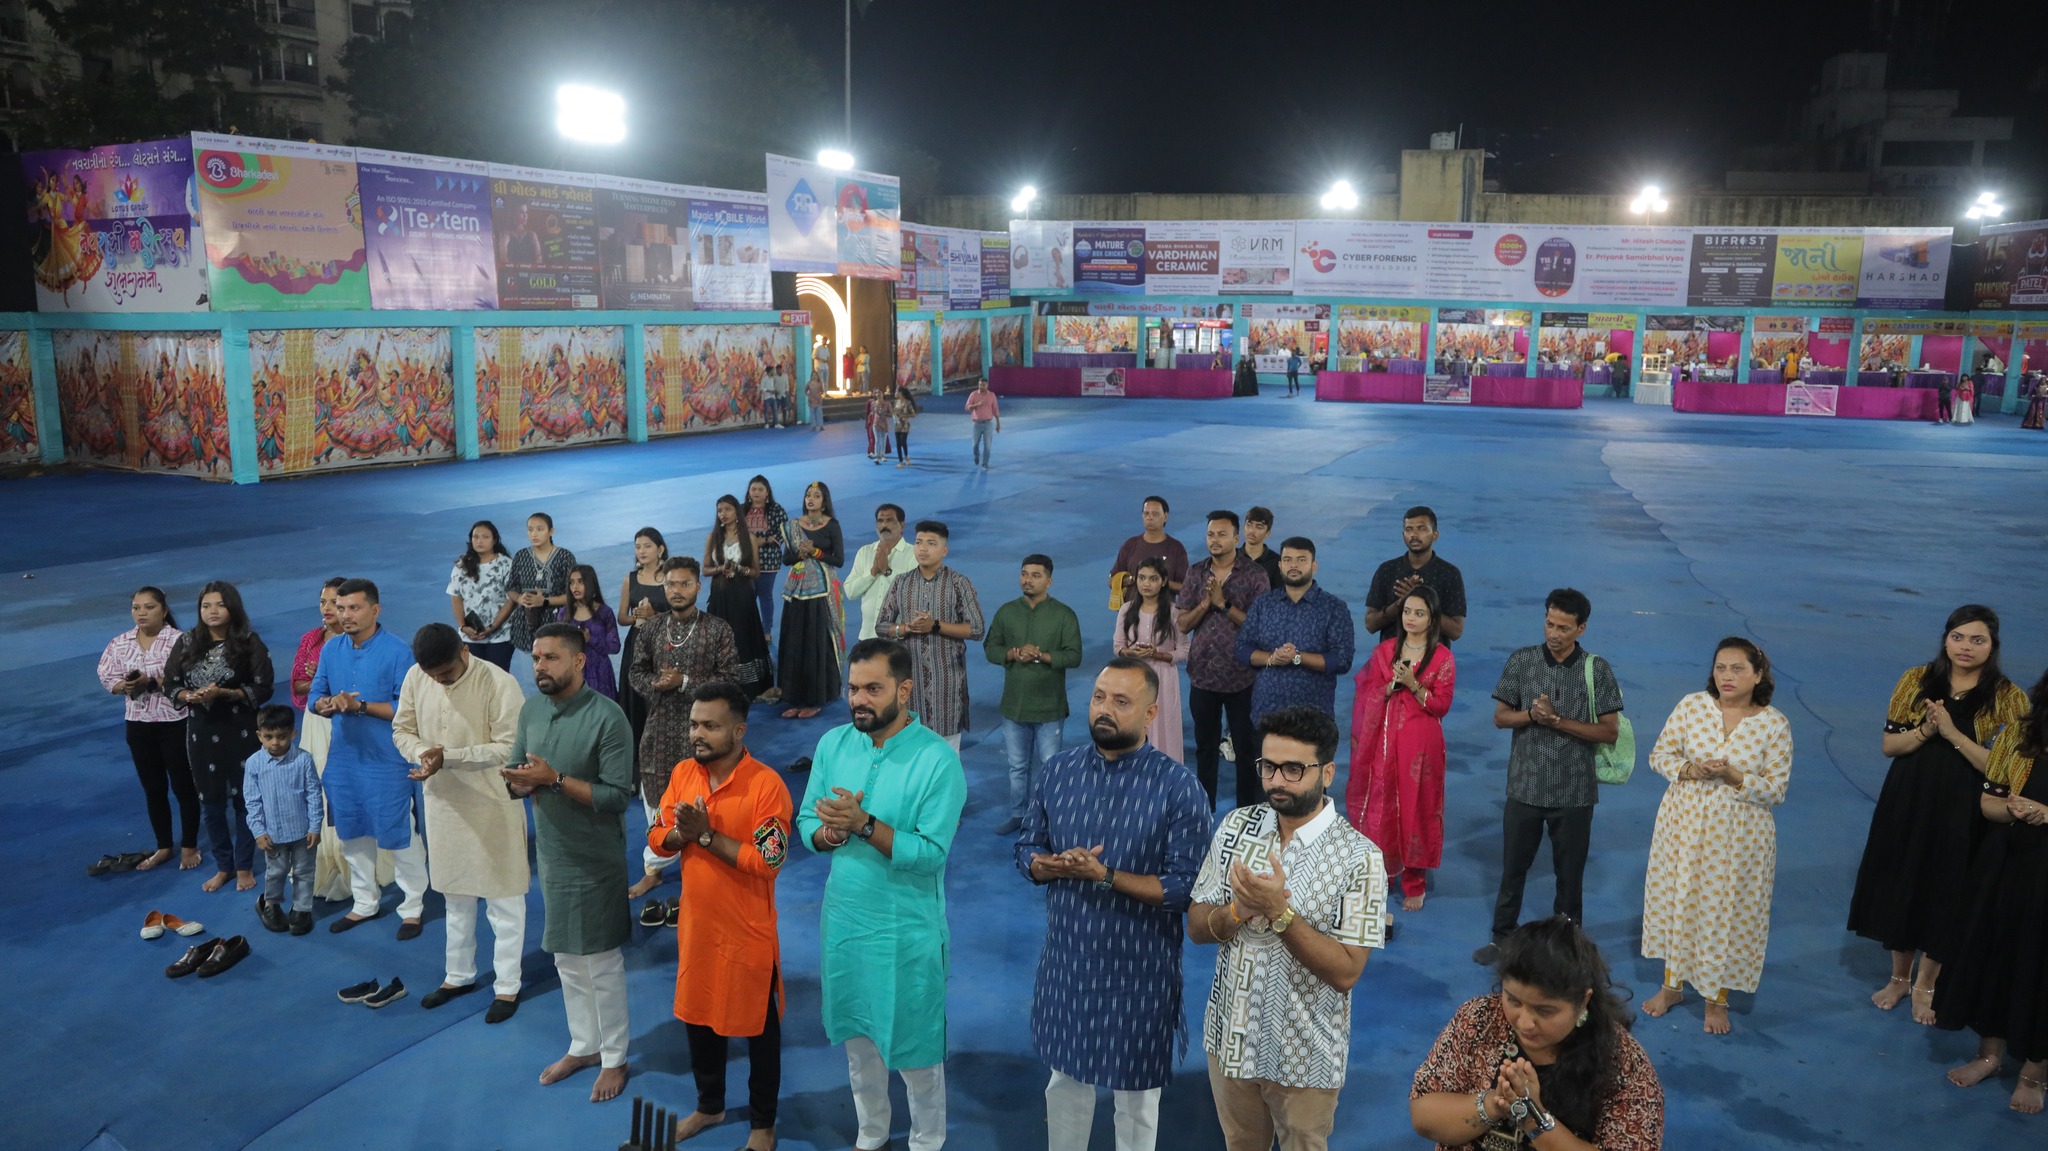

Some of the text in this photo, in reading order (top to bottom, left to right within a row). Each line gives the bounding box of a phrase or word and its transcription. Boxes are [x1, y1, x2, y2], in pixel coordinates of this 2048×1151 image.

[230, 167, 278, 181] Bharkadevi
[452, 201, 476, 209] Company
[691, 210, 713, 222] Magic
[746, 214, 765, 224] World
[1095, 241, 1124, 249] MATURE
[1251, 238, 1283, 251] VRM
[1705, 236, 1766, 245] BIFROST
[950, 253, 978, 264] SHIVAM
[1148, 250, 1217, 260] VARDHMAN
[1156, 262, 1208, 271] CERAMIC
[530, 278, 556, 287] GOLD
[2021, 279, 2043, 288] PATEL
[791, 314, 806, 323] EXIT
